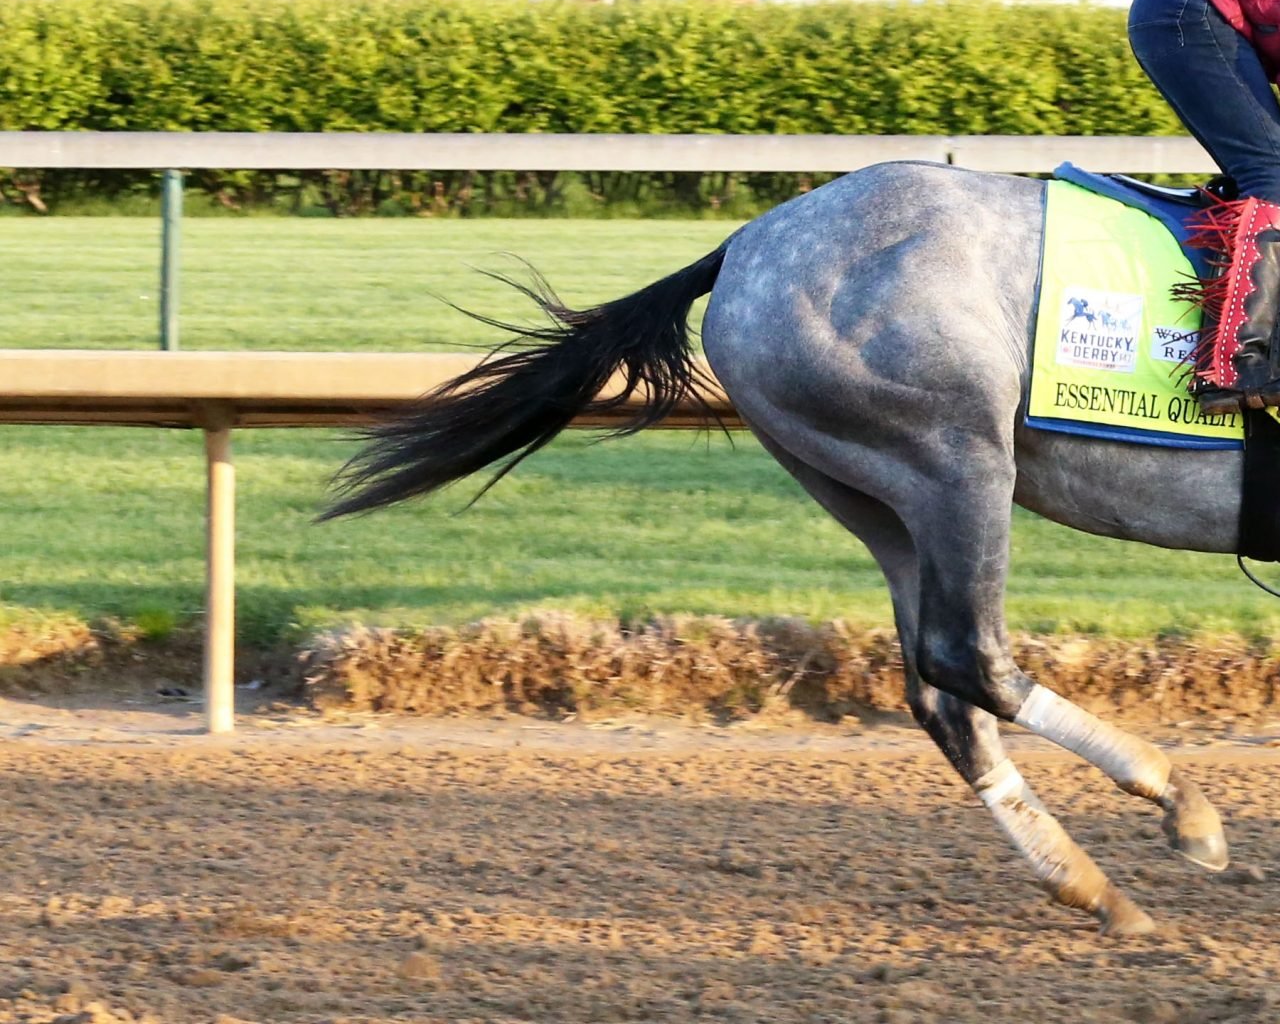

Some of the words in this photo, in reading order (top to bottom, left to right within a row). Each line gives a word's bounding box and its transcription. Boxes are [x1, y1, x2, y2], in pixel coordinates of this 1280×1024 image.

[1060, 328, 1134, 352] KENTUCKY
[1073, 345, 1119, 363] DERBY
[1054, 382, 1161, 419] ESSENTIAL
[1168, 396, 1245, 429] QUALIT
